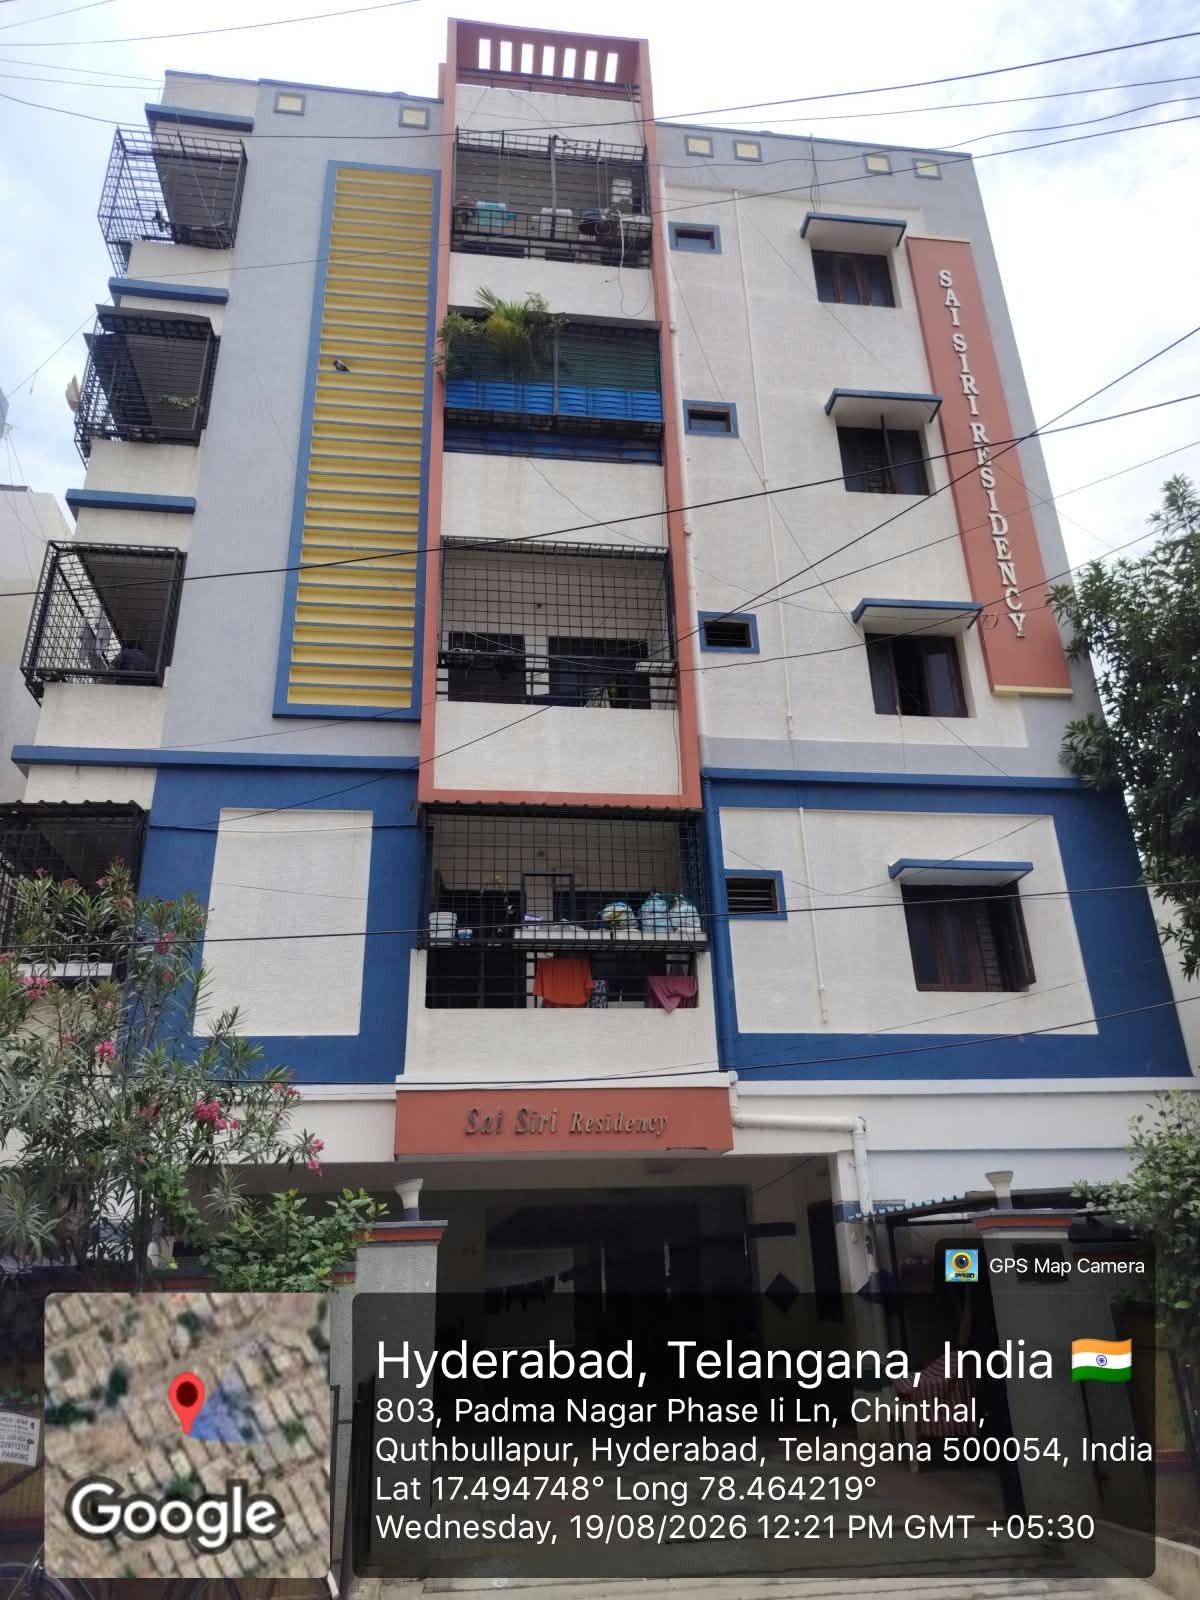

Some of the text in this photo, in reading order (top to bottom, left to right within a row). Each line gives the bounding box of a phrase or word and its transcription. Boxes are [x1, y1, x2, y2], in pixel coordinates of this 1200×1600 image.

[938, 269, 1026, 639] SAI SIRI RESIDENCY
[465, 1107, 669, 1137] Sai Siri Residency
